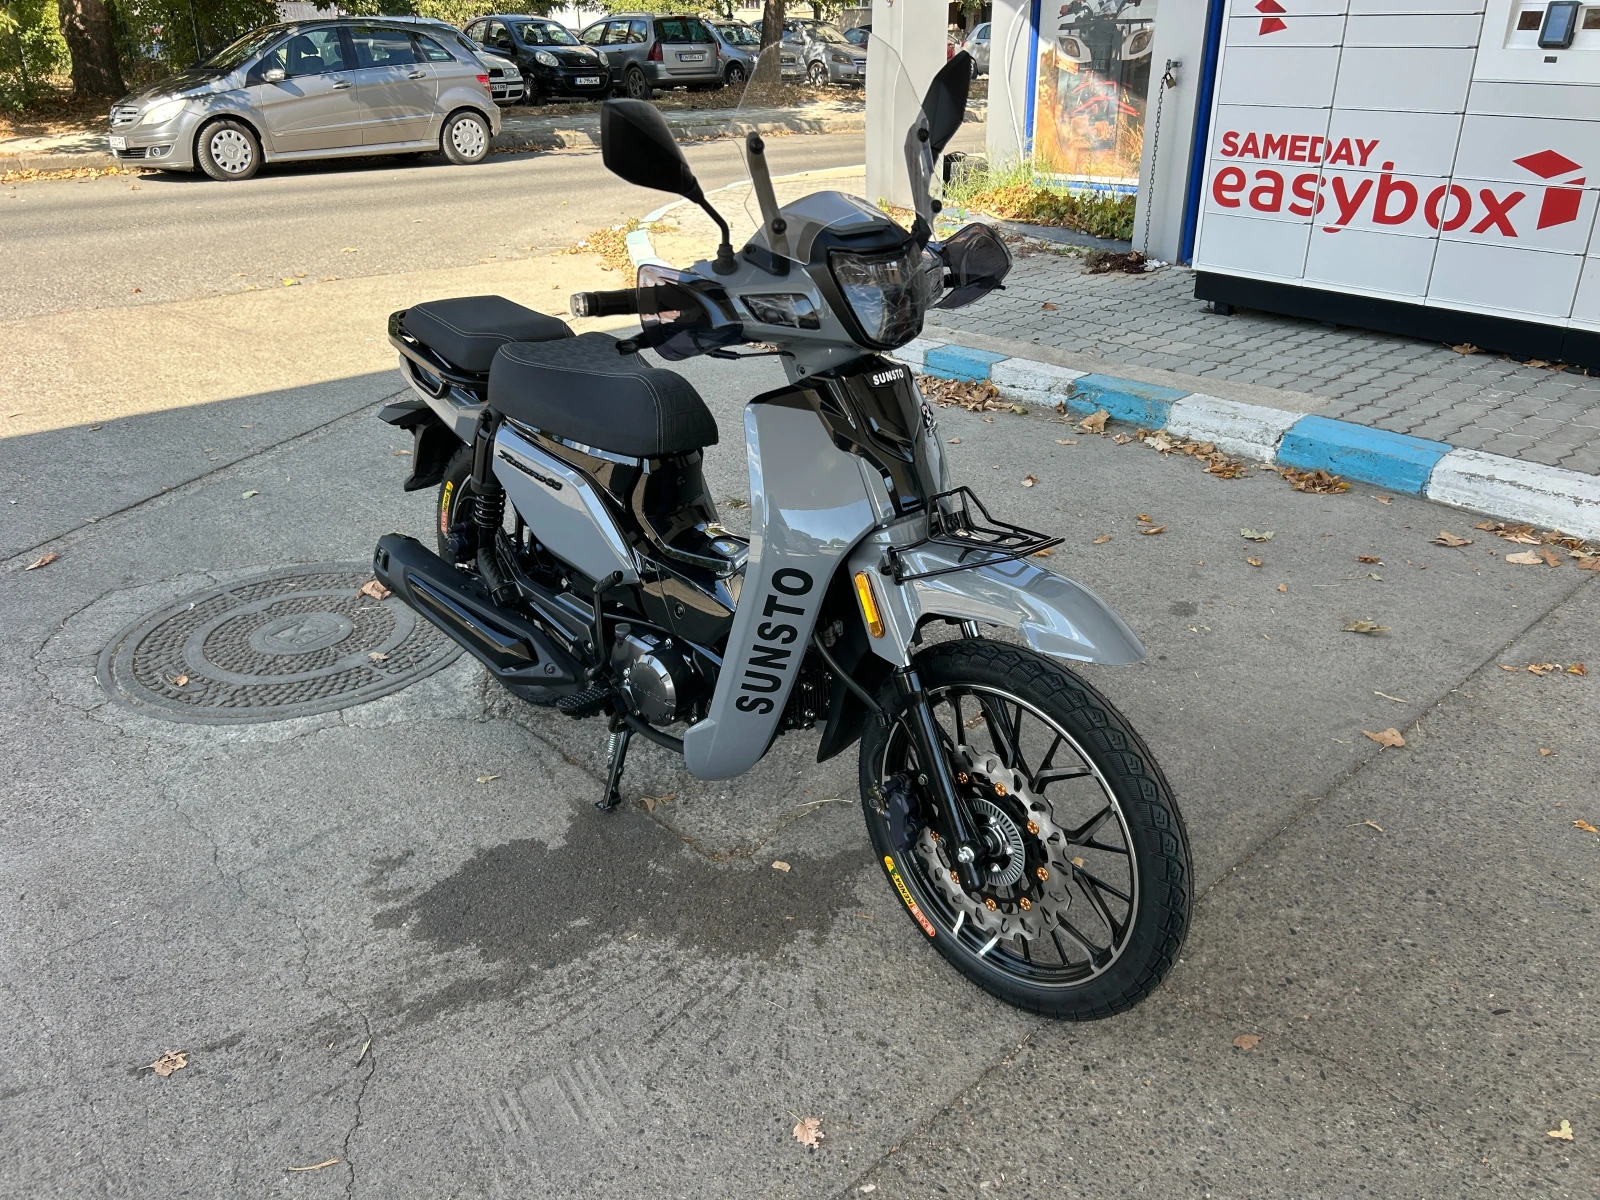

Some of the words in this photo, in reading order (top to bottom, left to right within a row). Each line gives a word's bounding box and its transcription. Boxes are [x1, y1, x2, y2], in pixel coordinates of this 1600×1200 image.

[1220, 131, 1380, 167] SAMEDAY
[1212, 161, 1527, 238] easybox
[872, 368, 904, 386] SUNSTO
[735, 567, 814, 715] SUNSTO
[895, 877, 914, 904] KENDA
